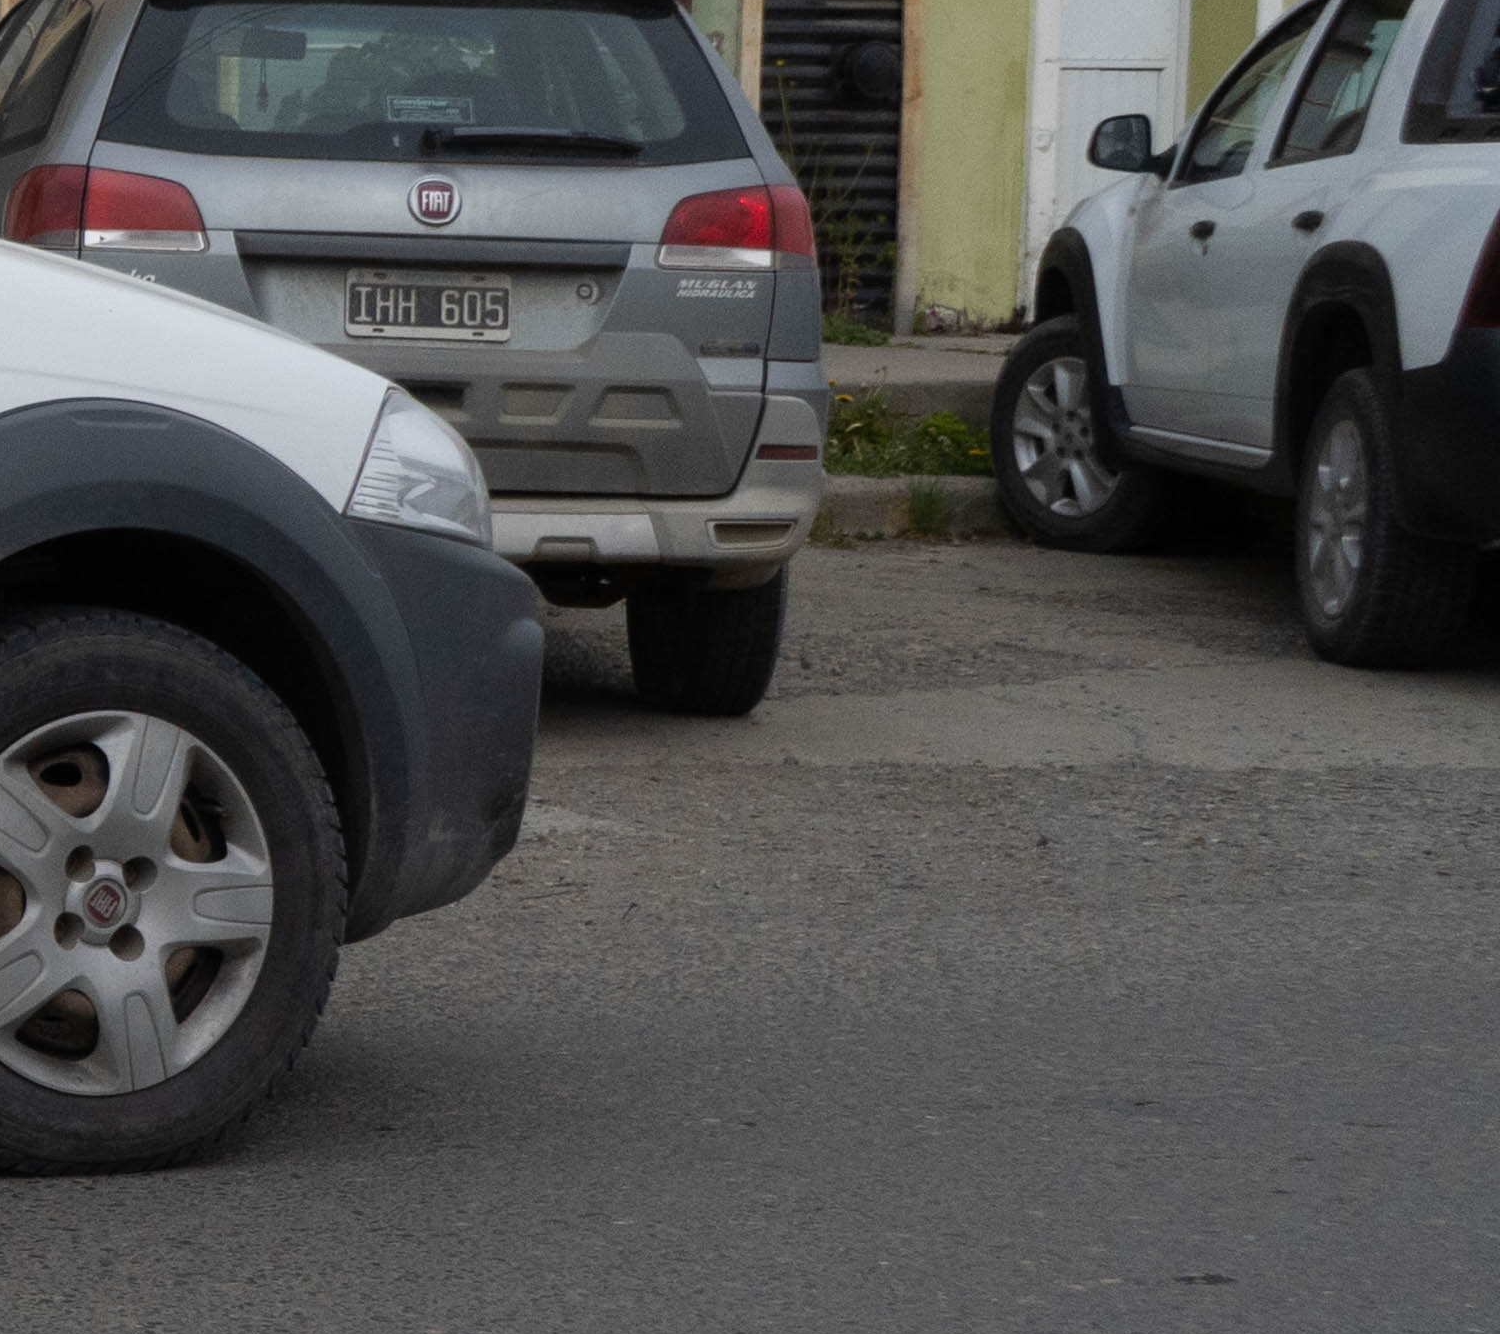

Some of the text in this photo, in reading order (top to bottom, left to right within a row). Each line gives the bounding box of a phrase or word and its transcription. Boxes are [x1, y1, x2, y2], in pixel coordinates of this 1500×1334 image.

[422, 190, 451, 212] FIAT
[355, 286, 504, 327] IHH 605
